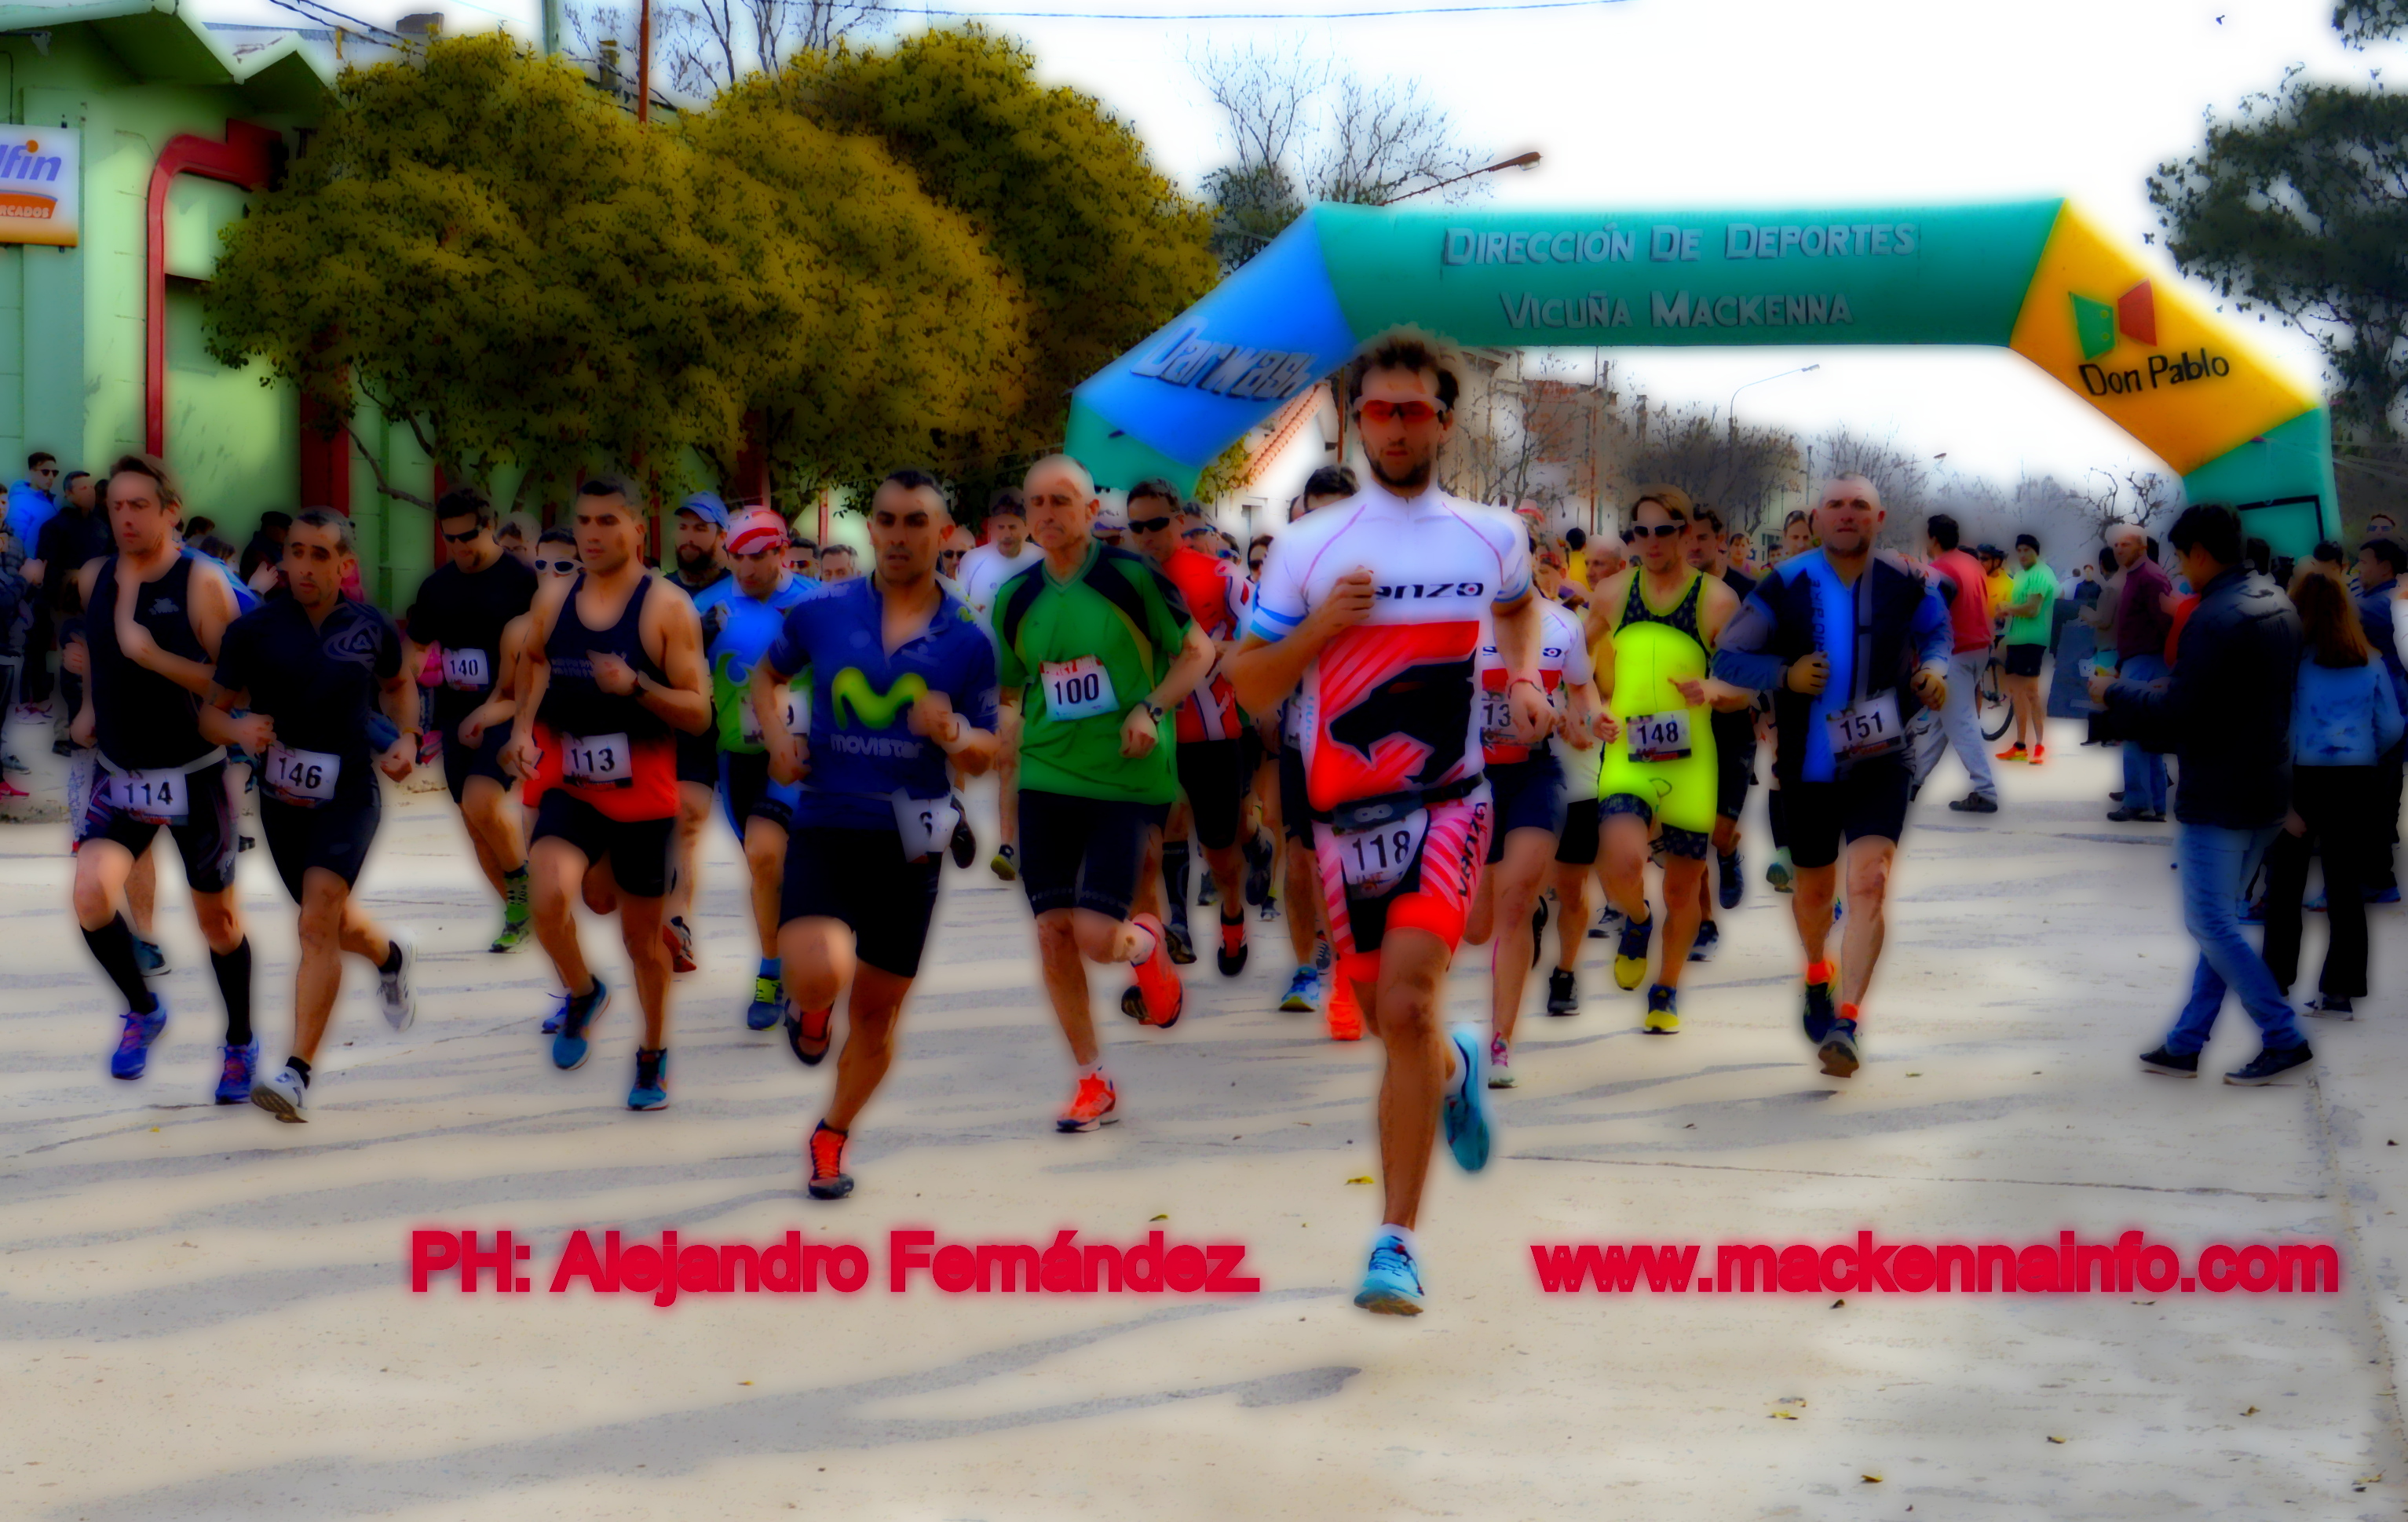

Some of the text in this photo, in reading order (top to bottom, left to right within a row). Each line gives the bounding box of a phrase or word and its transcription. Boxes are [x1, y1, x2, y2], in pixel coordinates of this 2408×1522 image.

[1650, 225, 1704, 262] DE
[1725, 222, 1917, 260] DEPORTES
[1500, 290, 1854, 330] VICUÑA MACKENNA
[2078, 348, 2230, 396] Don Pablo
[449, 659, 478, 677] 140
[1054, 673, 1099, 706] 100
[1482, 703, 1511, 728] 13
[1839, 711, 1884, 742] 151
[1637, 721, 1679, 745] 148
[278, 757, 323, 790] 146
[570, 747, 616, 773] 113
[123, 782, 174, 807] 114
[1351, 829, 1412, 871] 118
